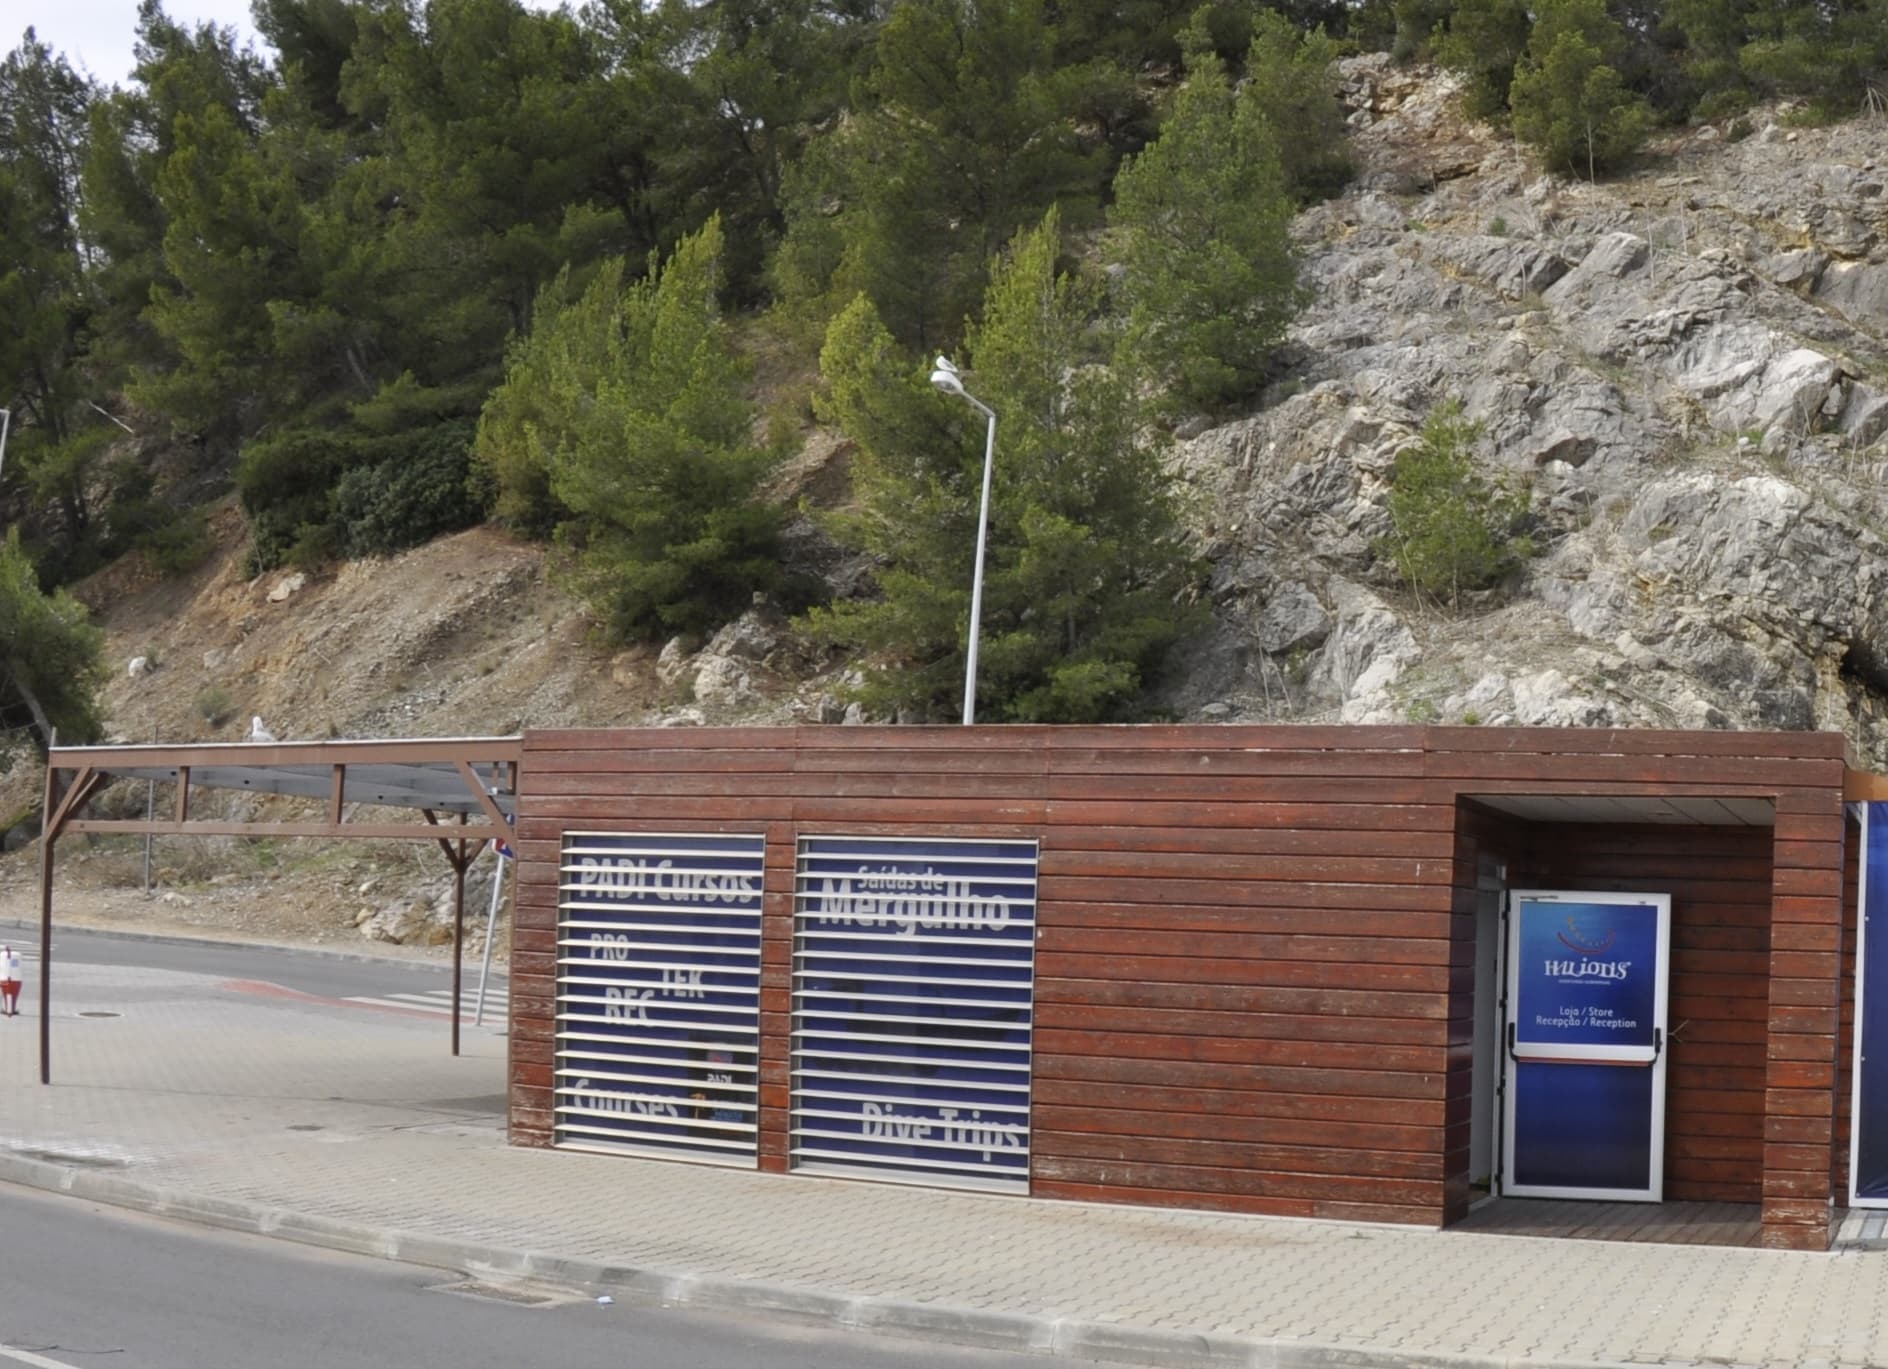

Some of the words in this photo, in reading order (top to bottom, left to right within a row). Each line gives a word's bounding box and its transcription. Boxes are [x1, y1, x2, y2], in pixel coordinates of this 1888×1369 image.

[579, 857, 646, 899] PADI
[653, 859, 753, 904] Cursos
[920, 866, 944, 891] de
[819, 876, 1010, 937] Mergulho
[590, 933, 629, 961] PRO
[1588, 1006, 1614, 1017] Store
[1590, 1017, 1637, 1030] Reception
[862, 1102, 932, 1140] Dive
